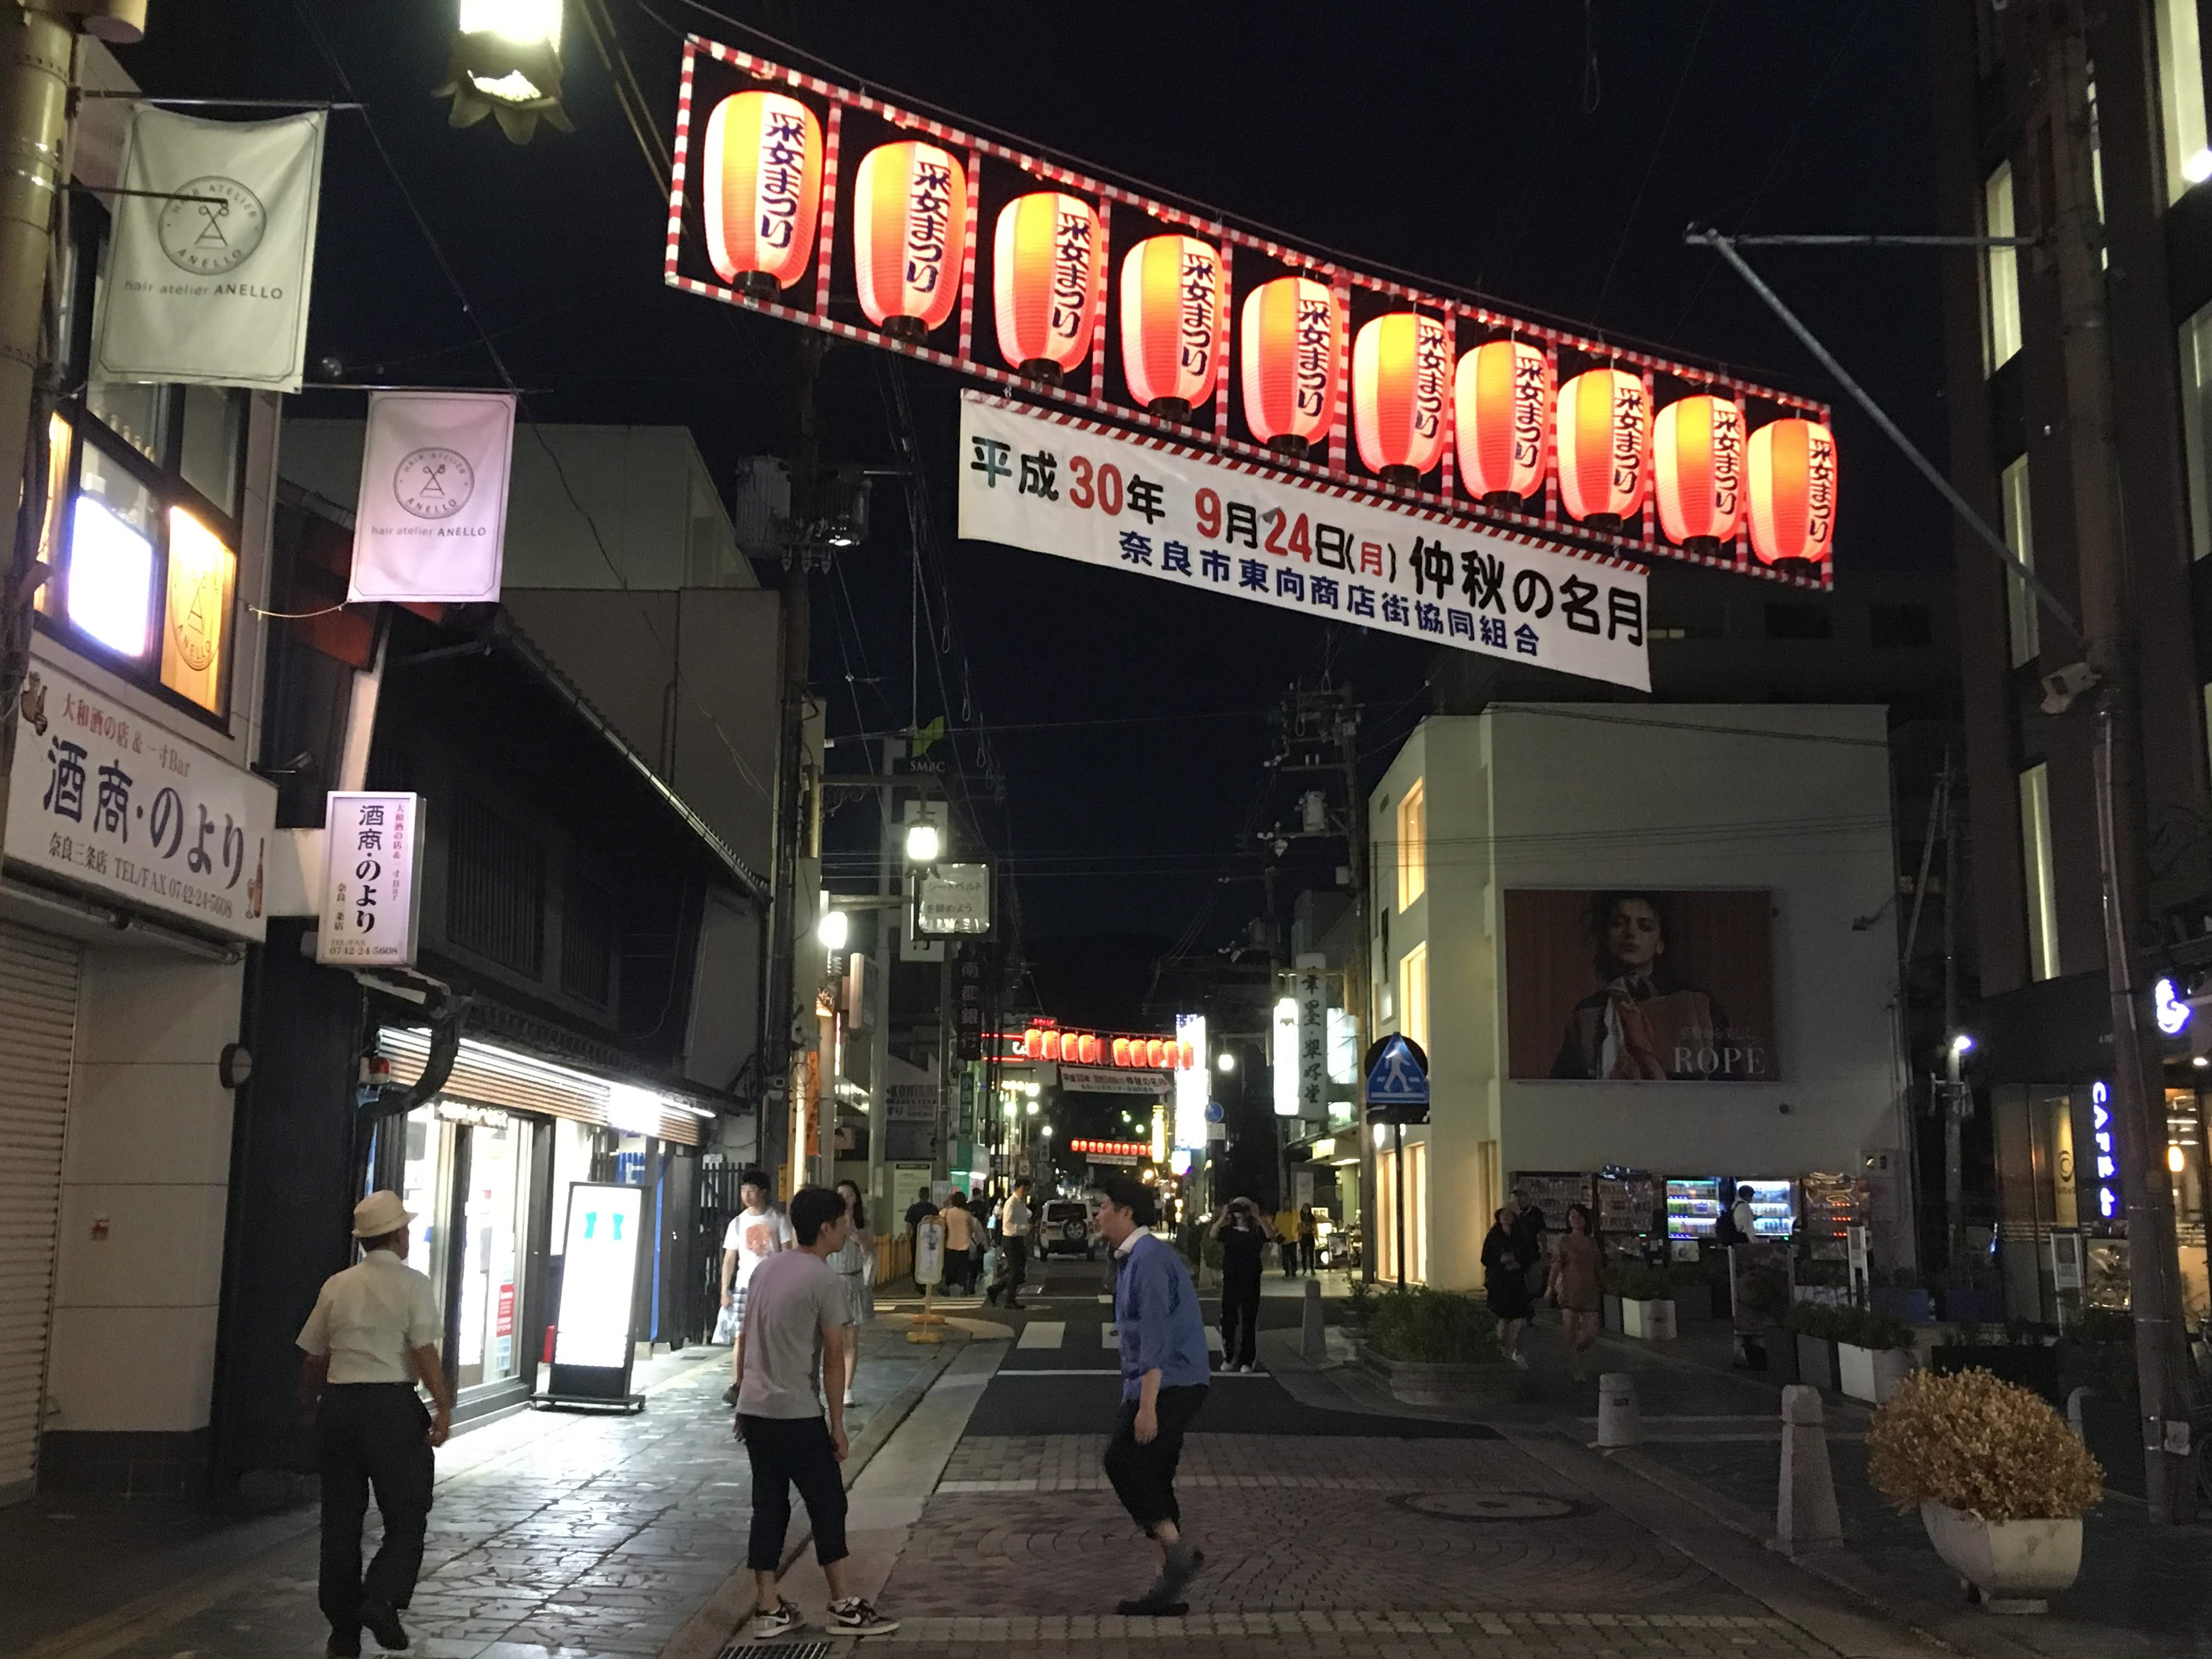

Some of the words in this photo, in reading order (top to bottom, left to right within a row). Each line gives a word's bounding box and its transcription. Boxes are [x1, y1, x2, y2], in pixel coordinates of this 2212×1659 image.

[208, 184, 258, 218] ATELIER
[177, 248, 242, 268] ANELLO
[159, 283, 209, 296] atelier
[213, 284, 283, 300] ANELLO
[406, 497, 456, 513] ANELLO
[371, 526, 393, 535] hair
[396, 527, 433, 536] atelier
[437, 527, 487, 537] ANELLO
[970, 435, 1166, 525] 平成30年
[1409, 535, 1643, 647] 仲秋の名月
[1119, 530, 1539, 657] 奈良市東向商店街協同組合
[49, 832, 109, 875] 奈良三条店
